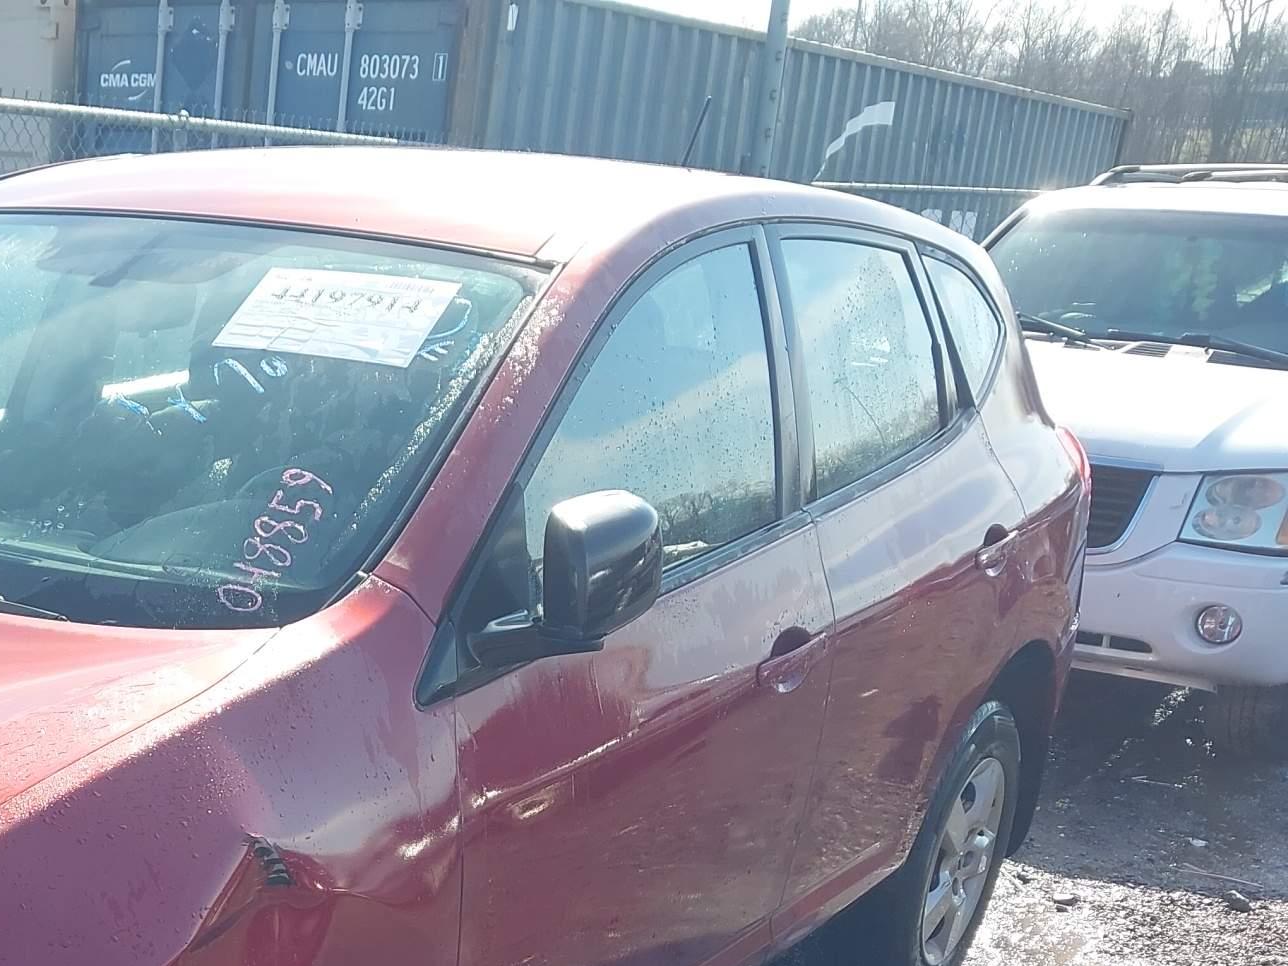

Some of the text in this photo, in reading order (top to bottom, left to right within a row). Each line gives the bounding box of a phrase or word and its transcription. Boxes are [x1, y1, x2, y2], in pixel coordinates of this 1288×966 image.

[296, 53, 338, 77] CMAU
[359, 55, 419, 79] 803073
[100, 72, 129, 88] CMA
[357, 87, 395, 111] 42G1
